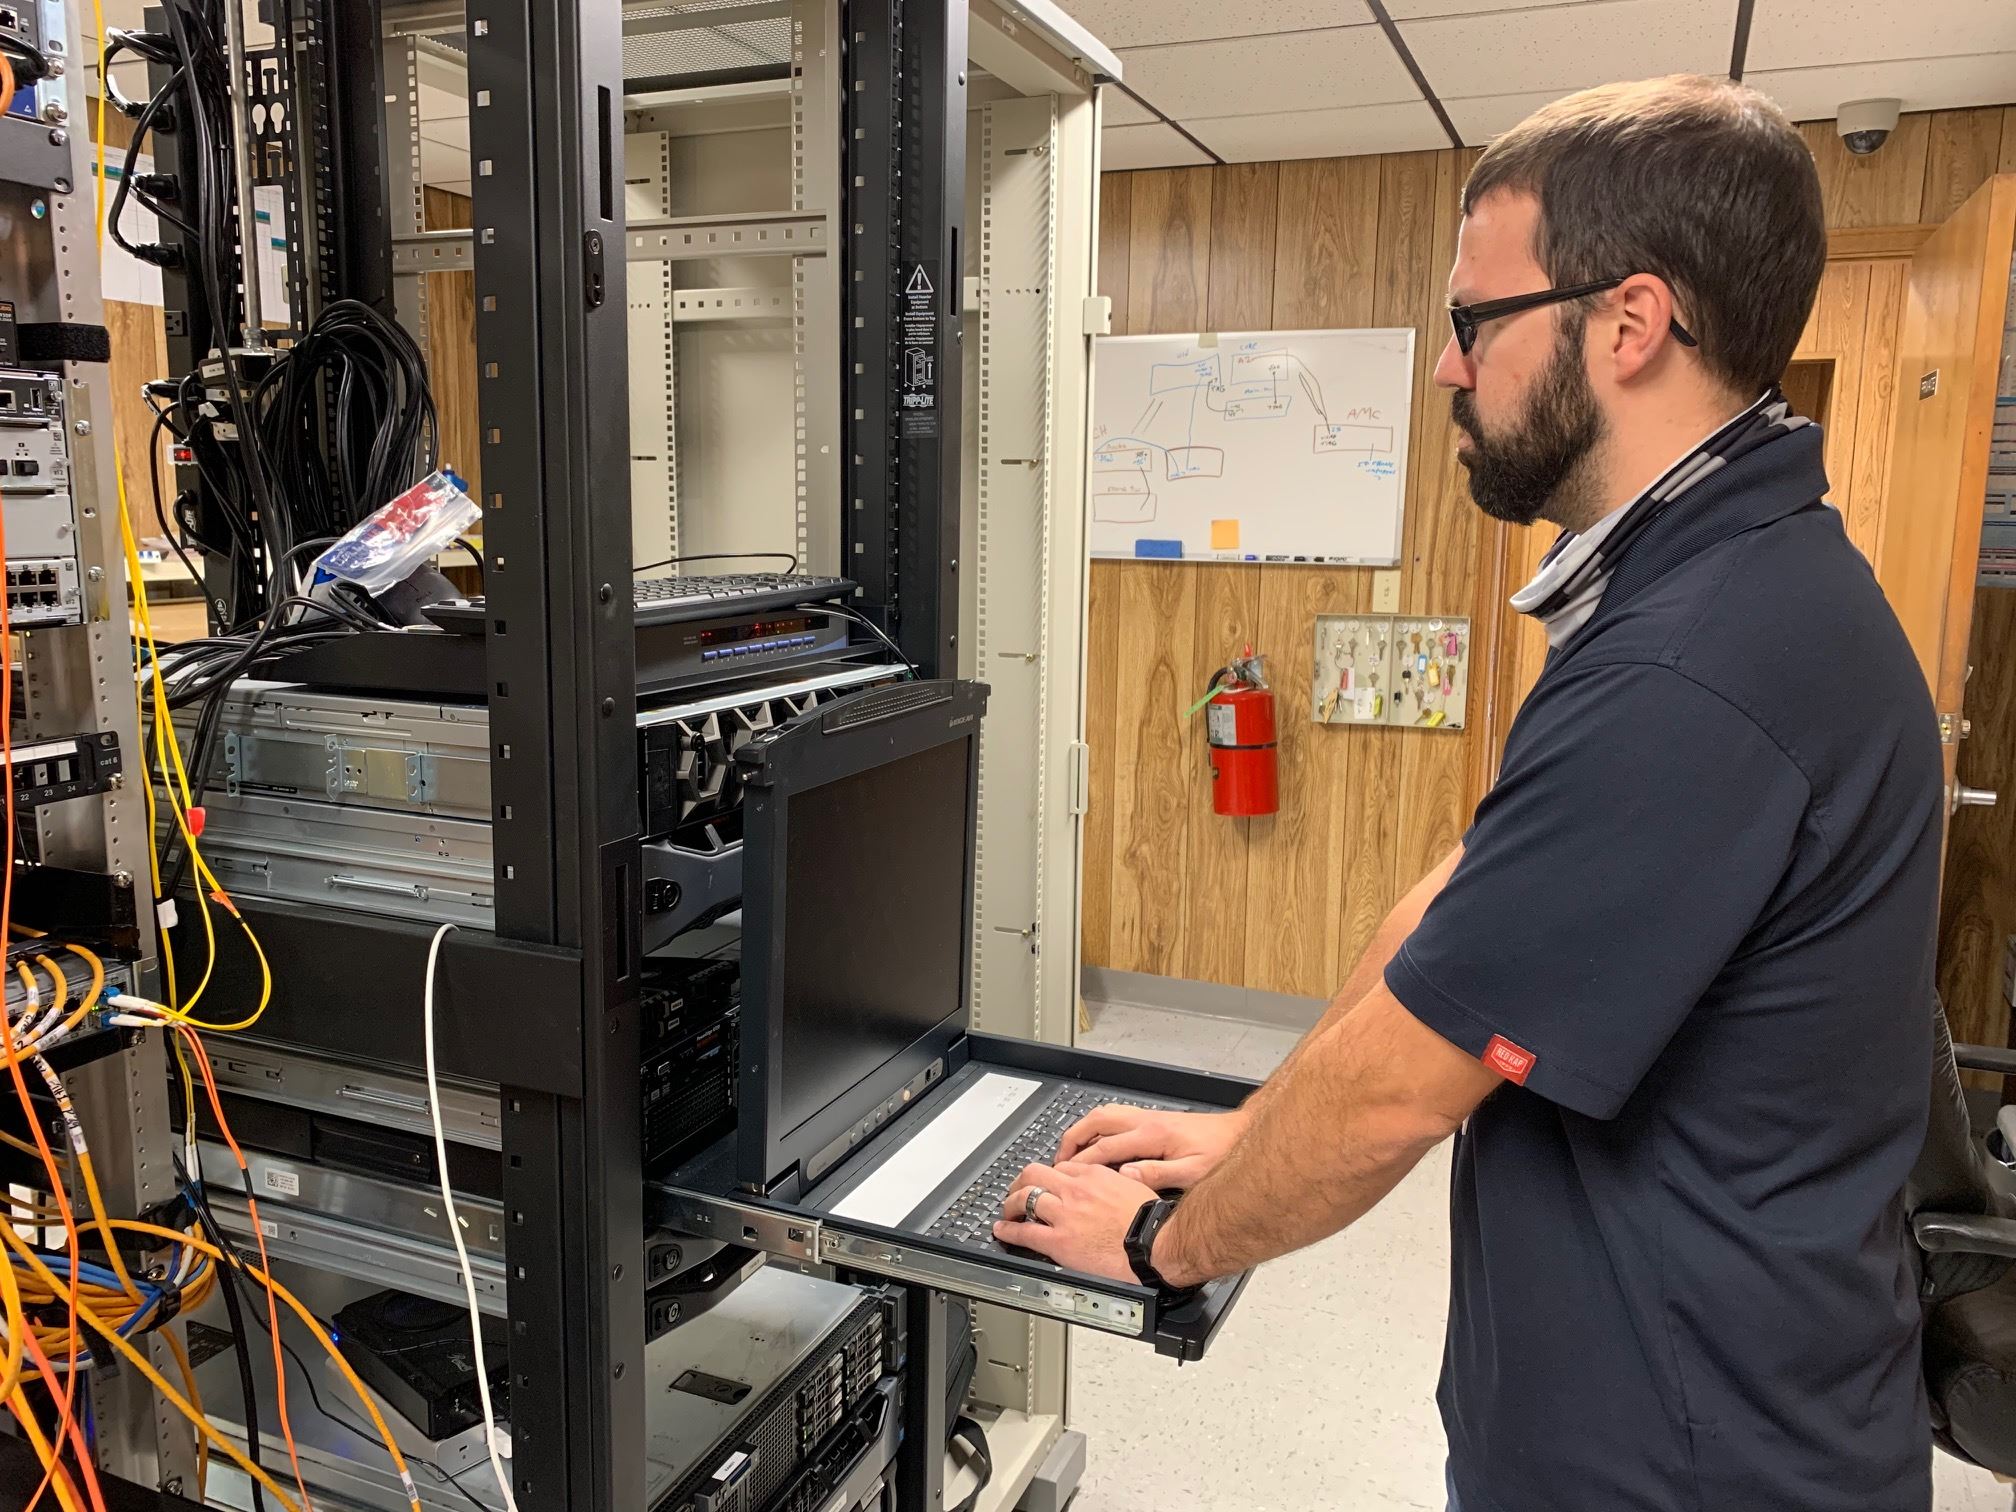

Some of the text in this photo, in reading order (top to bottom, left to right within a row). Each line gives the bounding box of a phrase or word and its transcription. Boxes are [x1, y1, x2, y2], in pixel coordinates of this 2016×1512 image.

[1347, 406, 1382, 420] AMC
[100, 755, 118, 766] cat 6
[44, 788, 54, 797] 23
[67, 785, 76, 793] 24
[20, 793, 30, 801] 22
